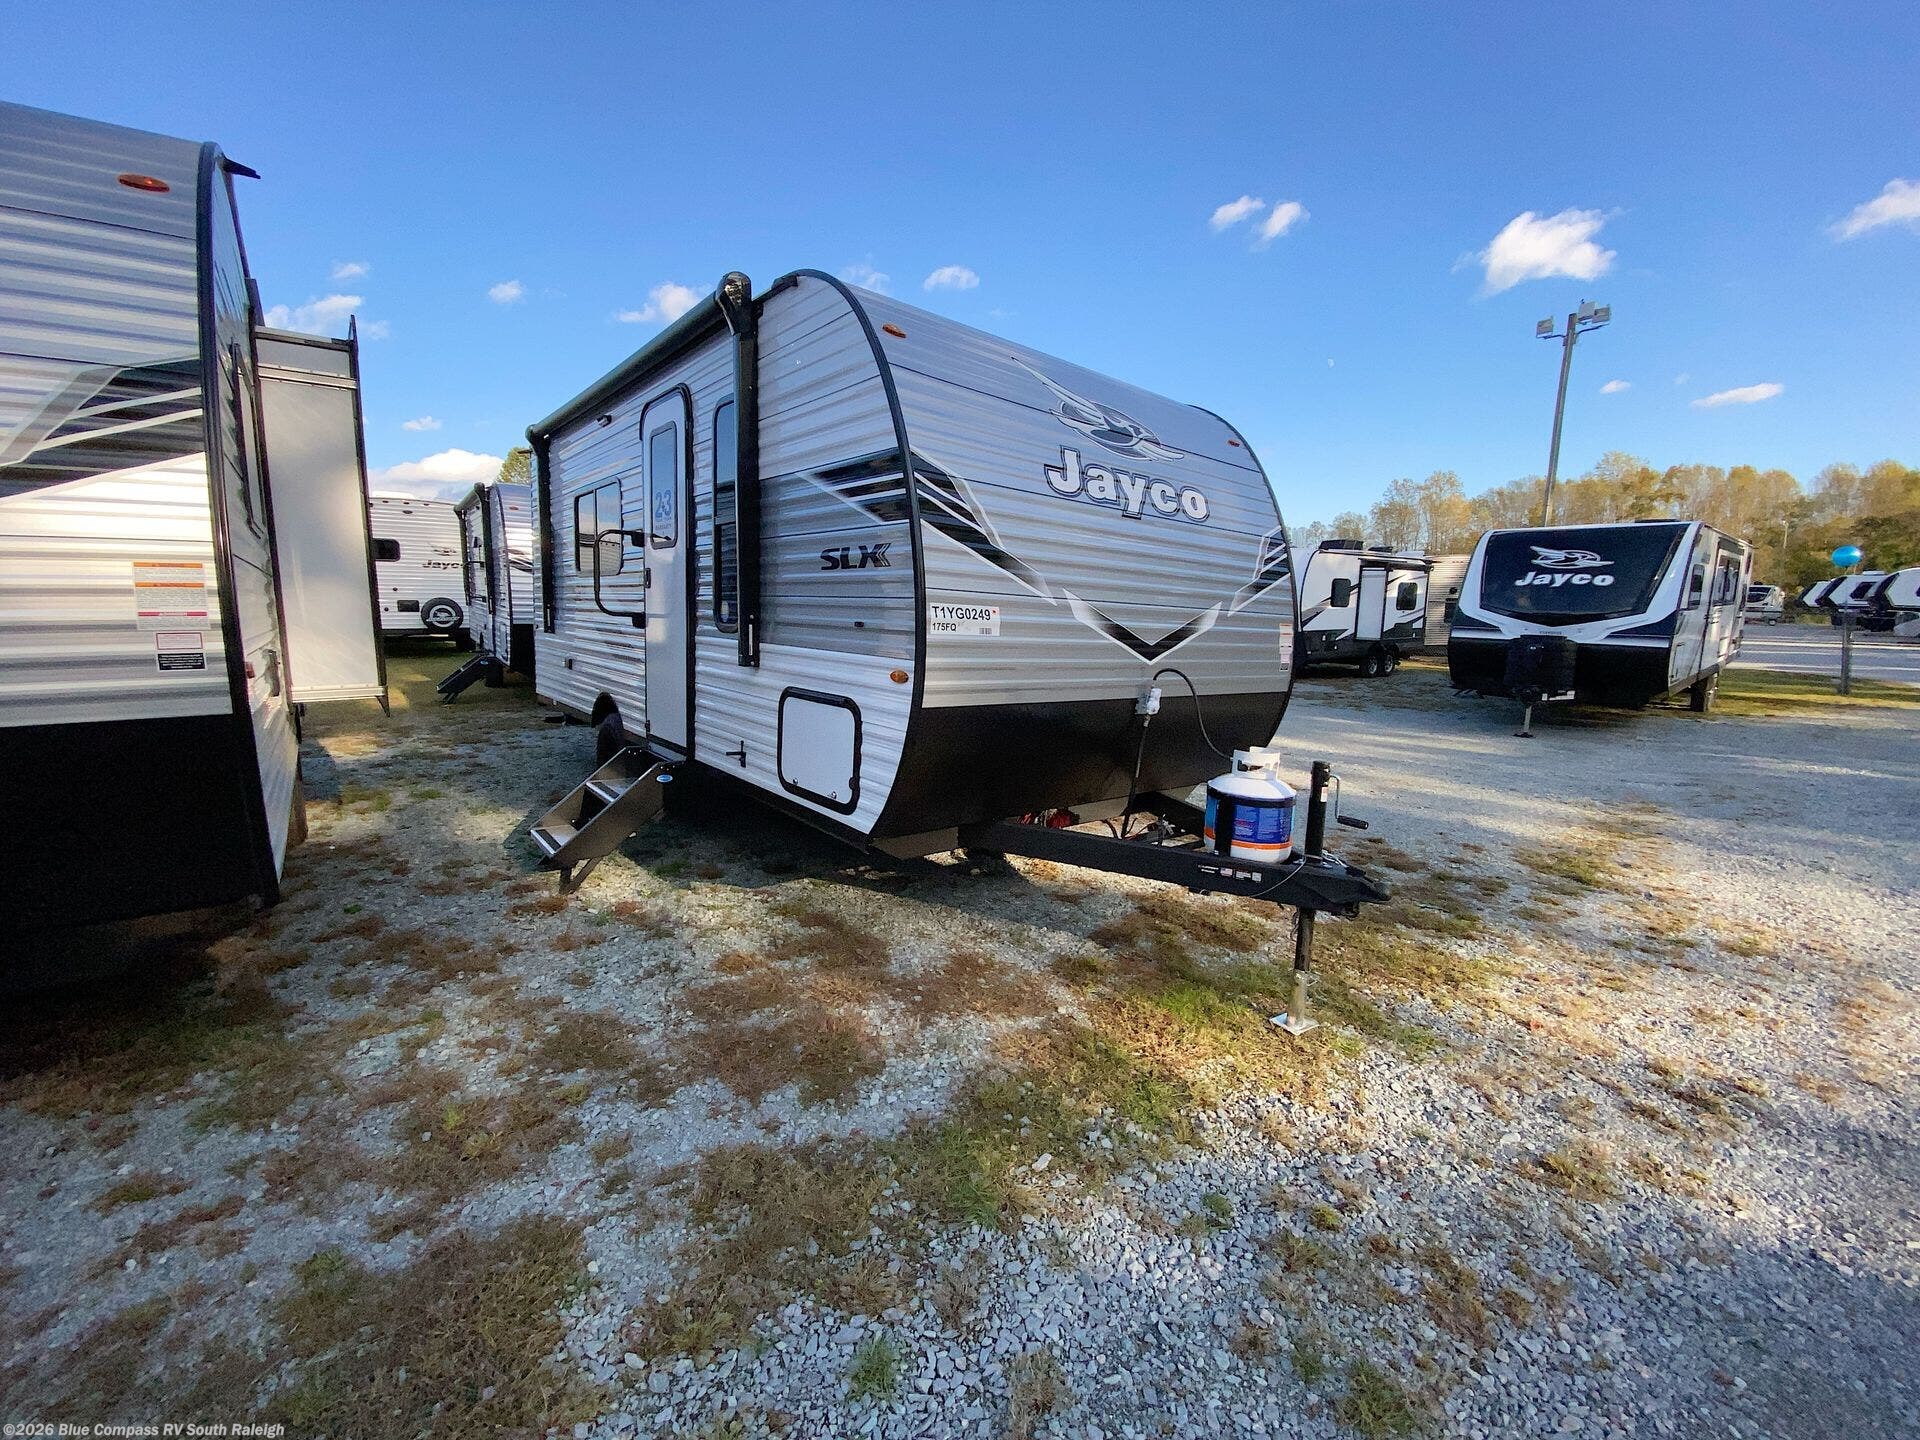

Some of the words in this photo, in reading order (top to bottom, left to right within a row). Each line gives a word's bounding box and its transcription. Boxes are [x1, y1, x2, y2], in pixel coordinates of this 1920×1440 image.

[1044, 445, 1210, 522] Jayco
[820, 543, 891, 570] SLX
[1514, 571, 1615, 587] Jayco
[931, 605, 991, 621] T1YG0249
[932, 622, 957, 632] 175FQ
